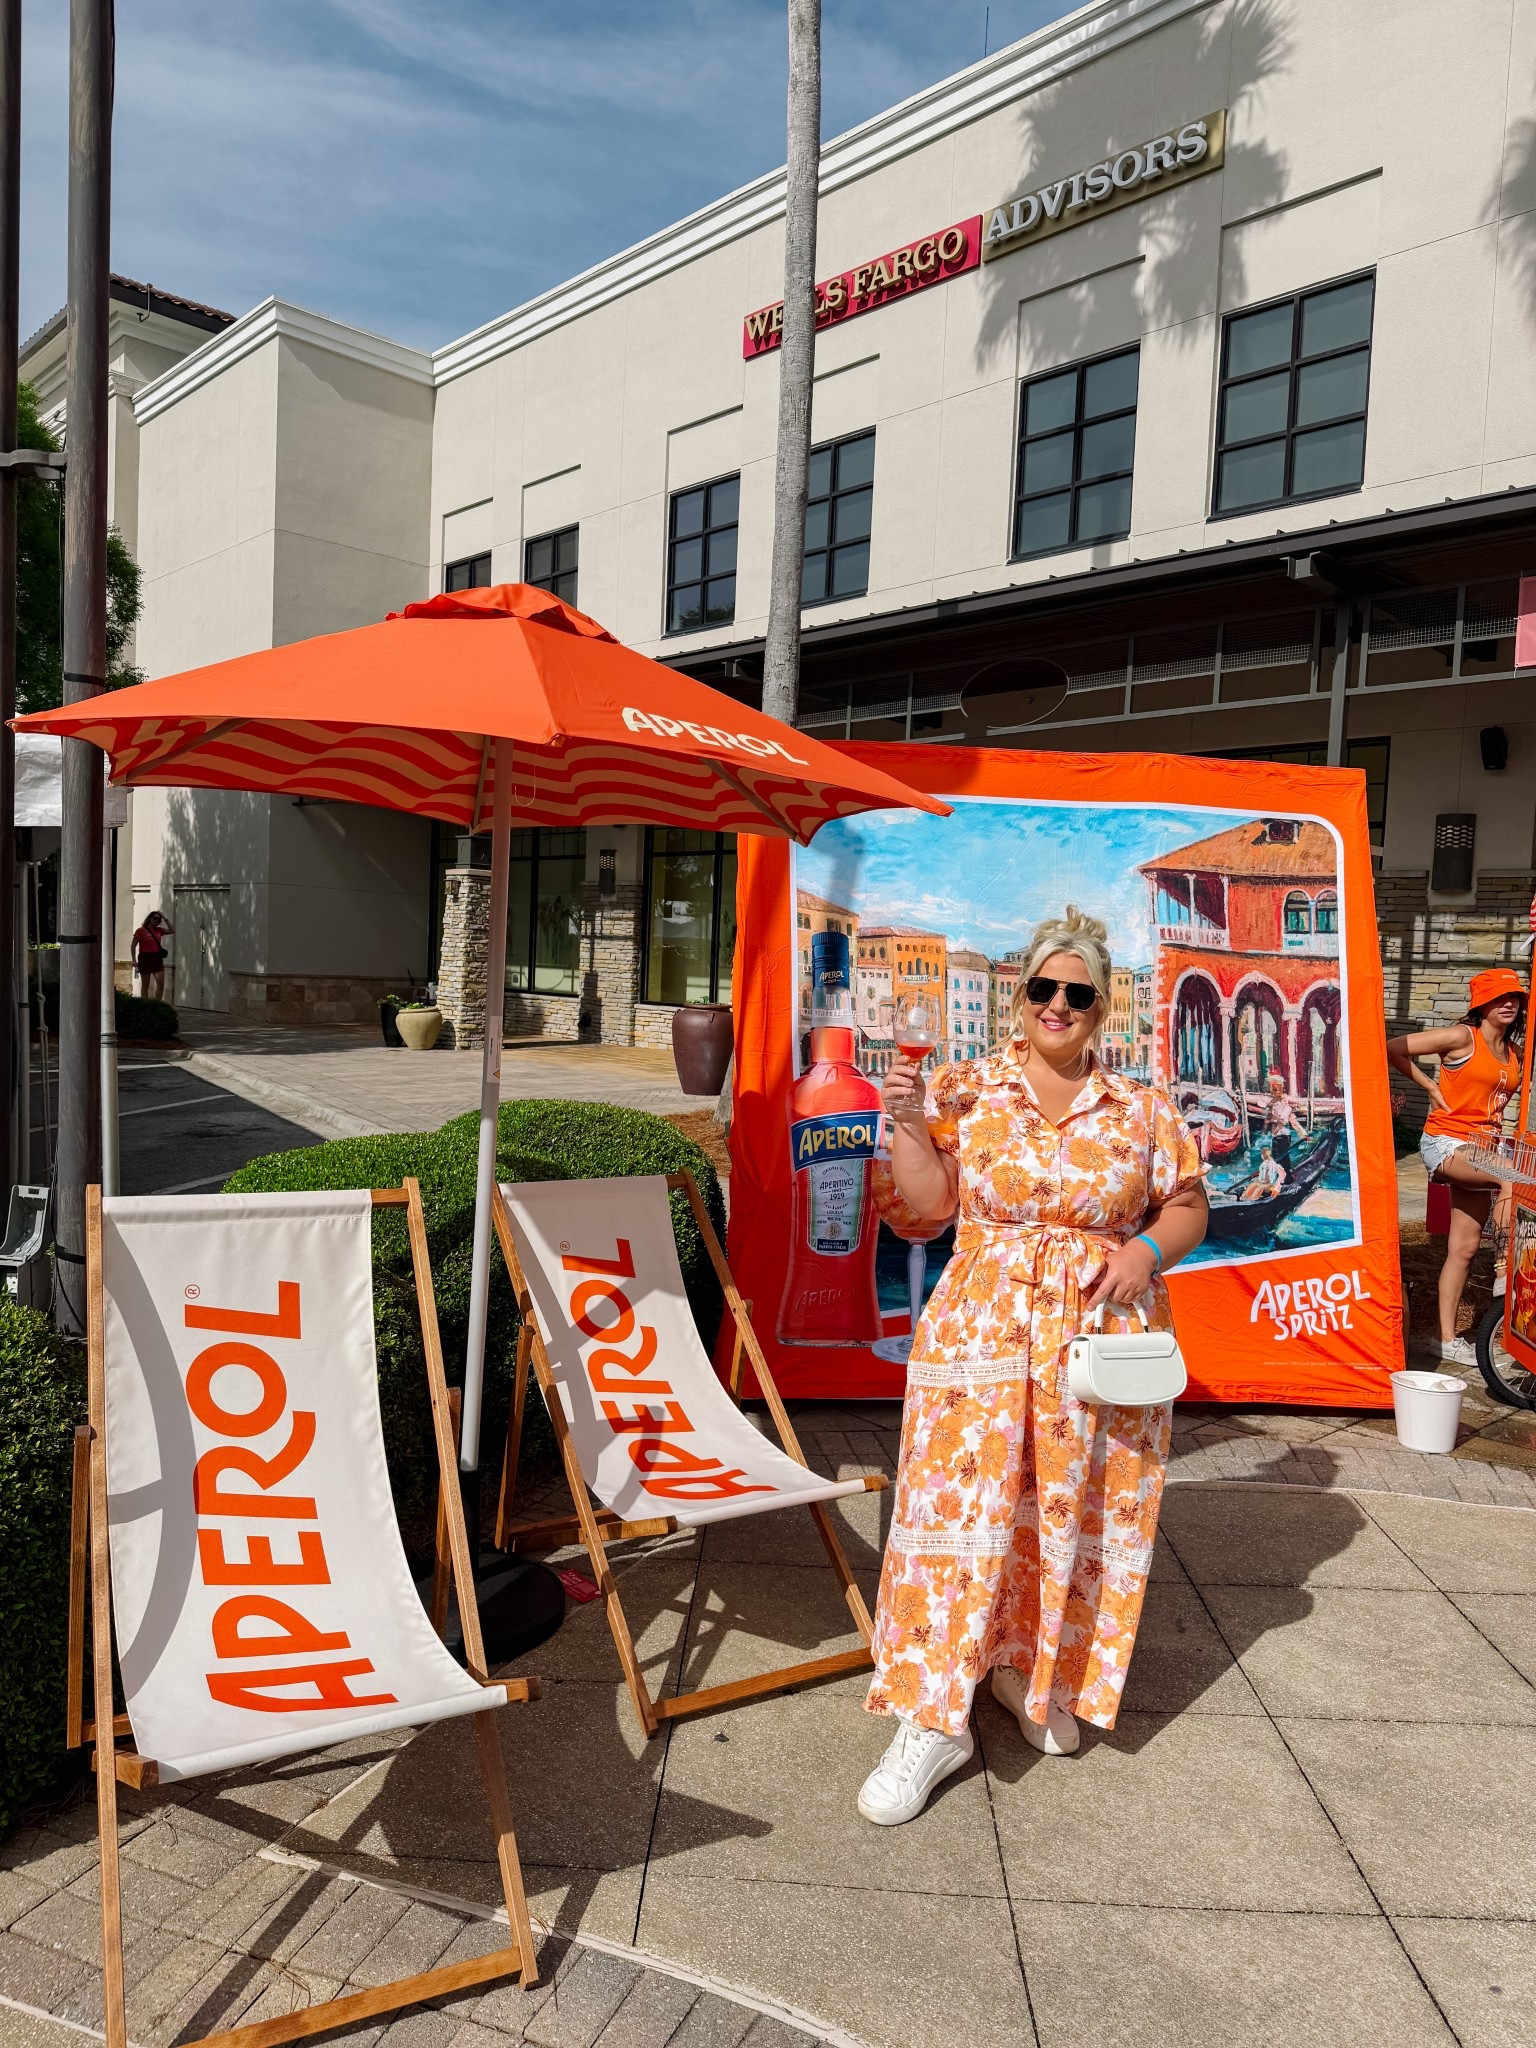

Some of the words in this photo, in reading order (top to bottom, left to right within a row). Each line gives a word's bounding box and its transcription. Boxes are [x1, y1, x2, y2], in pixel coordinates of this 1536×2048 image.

[745, 276, 847, 341] WELS
[851, 228, 967, 299] FARGO
[984, 120, 1210, 247] ADVISORS
[621, 706, 810, 766] APEROL
[818, 970, 845, 983] APEROL
[799, 1125, 875, 1160] APEROL
[820, 1178, 854, 1190] APERITIVO
[830, 1192, 845, 1201] 1919
[1518, 1220, 1536, 1238] APER
[1250, 1270, 1371, 1323] APEROL
[562, 1238, 780, 1500] APEROL
[184, 1280, 399, 1713] APEROL
